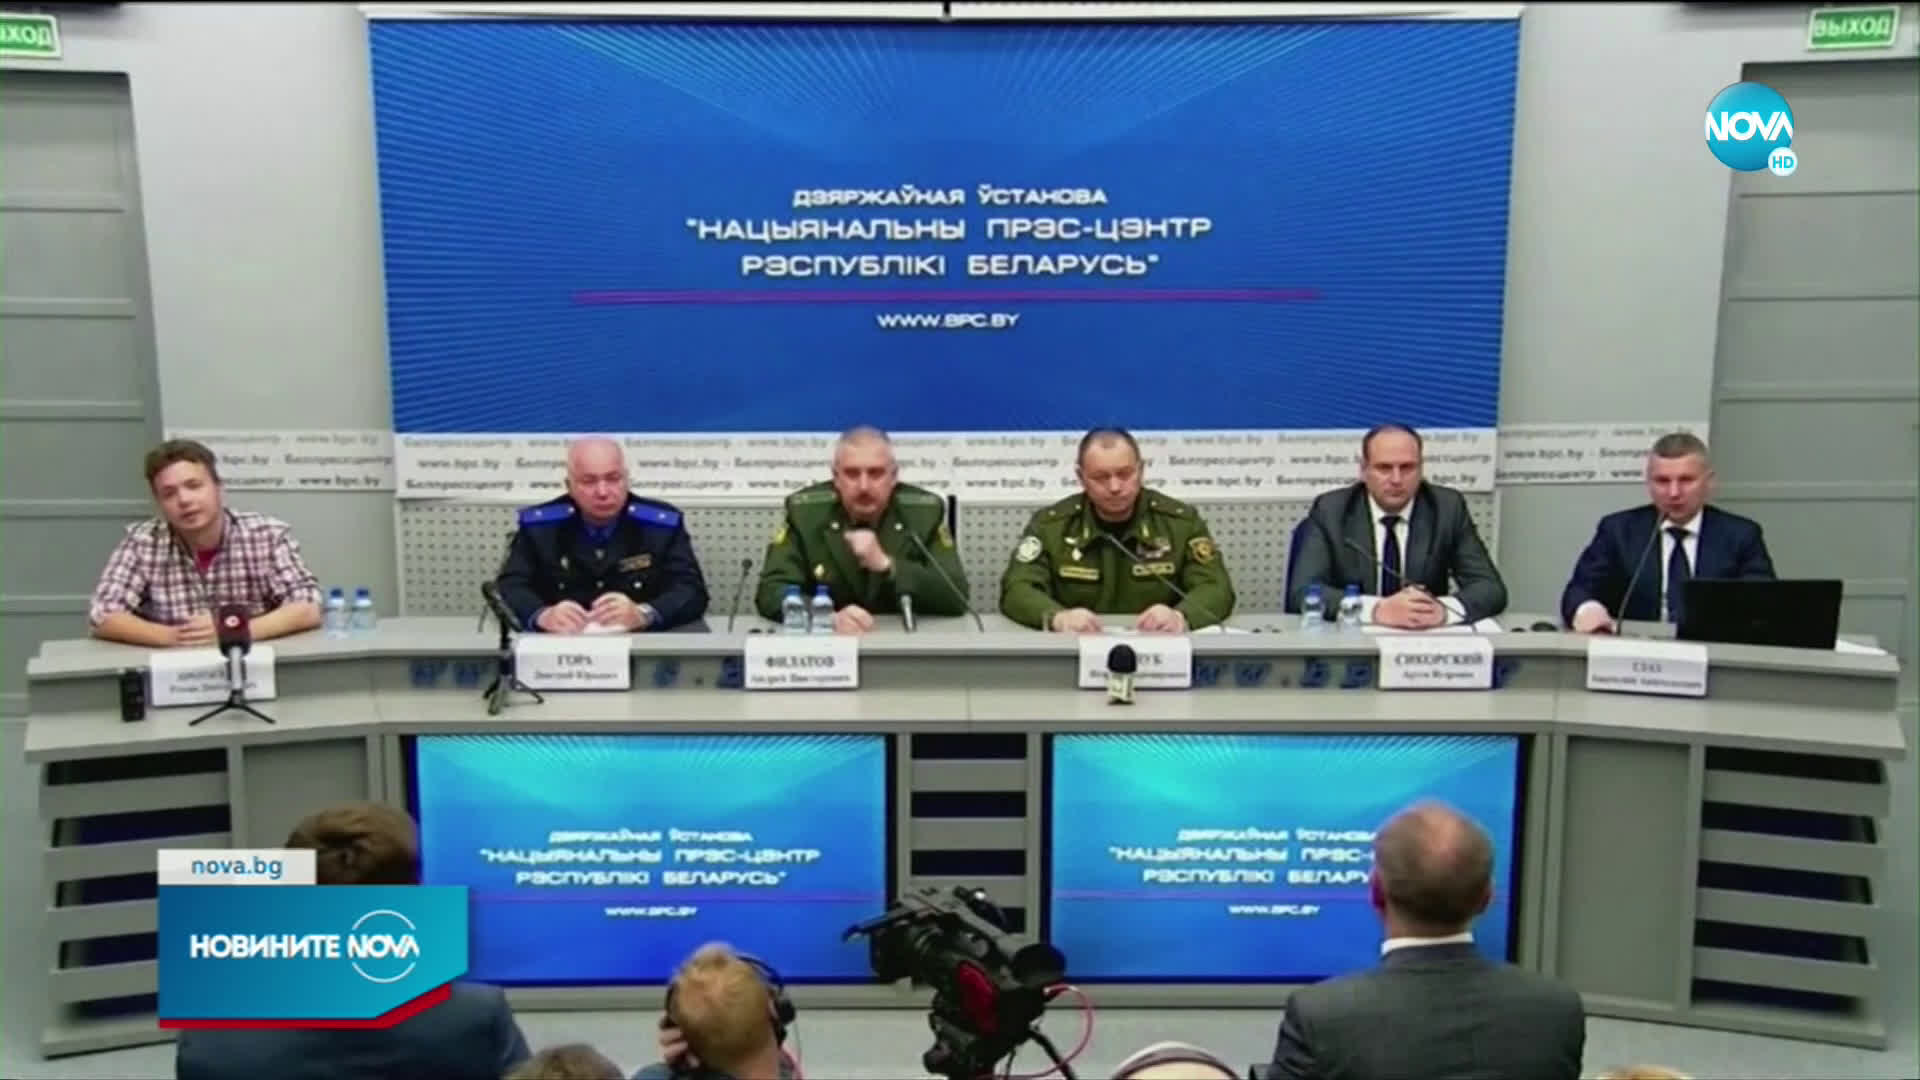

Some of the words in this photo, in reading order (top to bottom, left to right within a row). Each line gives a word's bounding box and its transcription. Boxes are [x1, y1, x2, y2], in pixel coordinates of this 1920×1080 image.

[0, 24, 52, 47] ХОД
[1813, 14, 1891, 38] ВЫХОД
[792, 186, 965, 208] ДЗЯРЖАЎНАЯ
[977, 185, 1108, 206] ЎСТАНОВА
[686, 218, 965, 243] "НАЦЫЯНАЛЬНЫ
[987, 217, 1212, 243] ПРЭС-ЦЭНТР
[741, 254, 946, 277] РЭСПУБЛІКІ
[967, 253, 1159, 276] БЕЛАРУСЬ"
[876, 312, 1021, 329] WWW.BPC.BY
[662, 870, 787, 885] БЕЛАРУСЬ"
